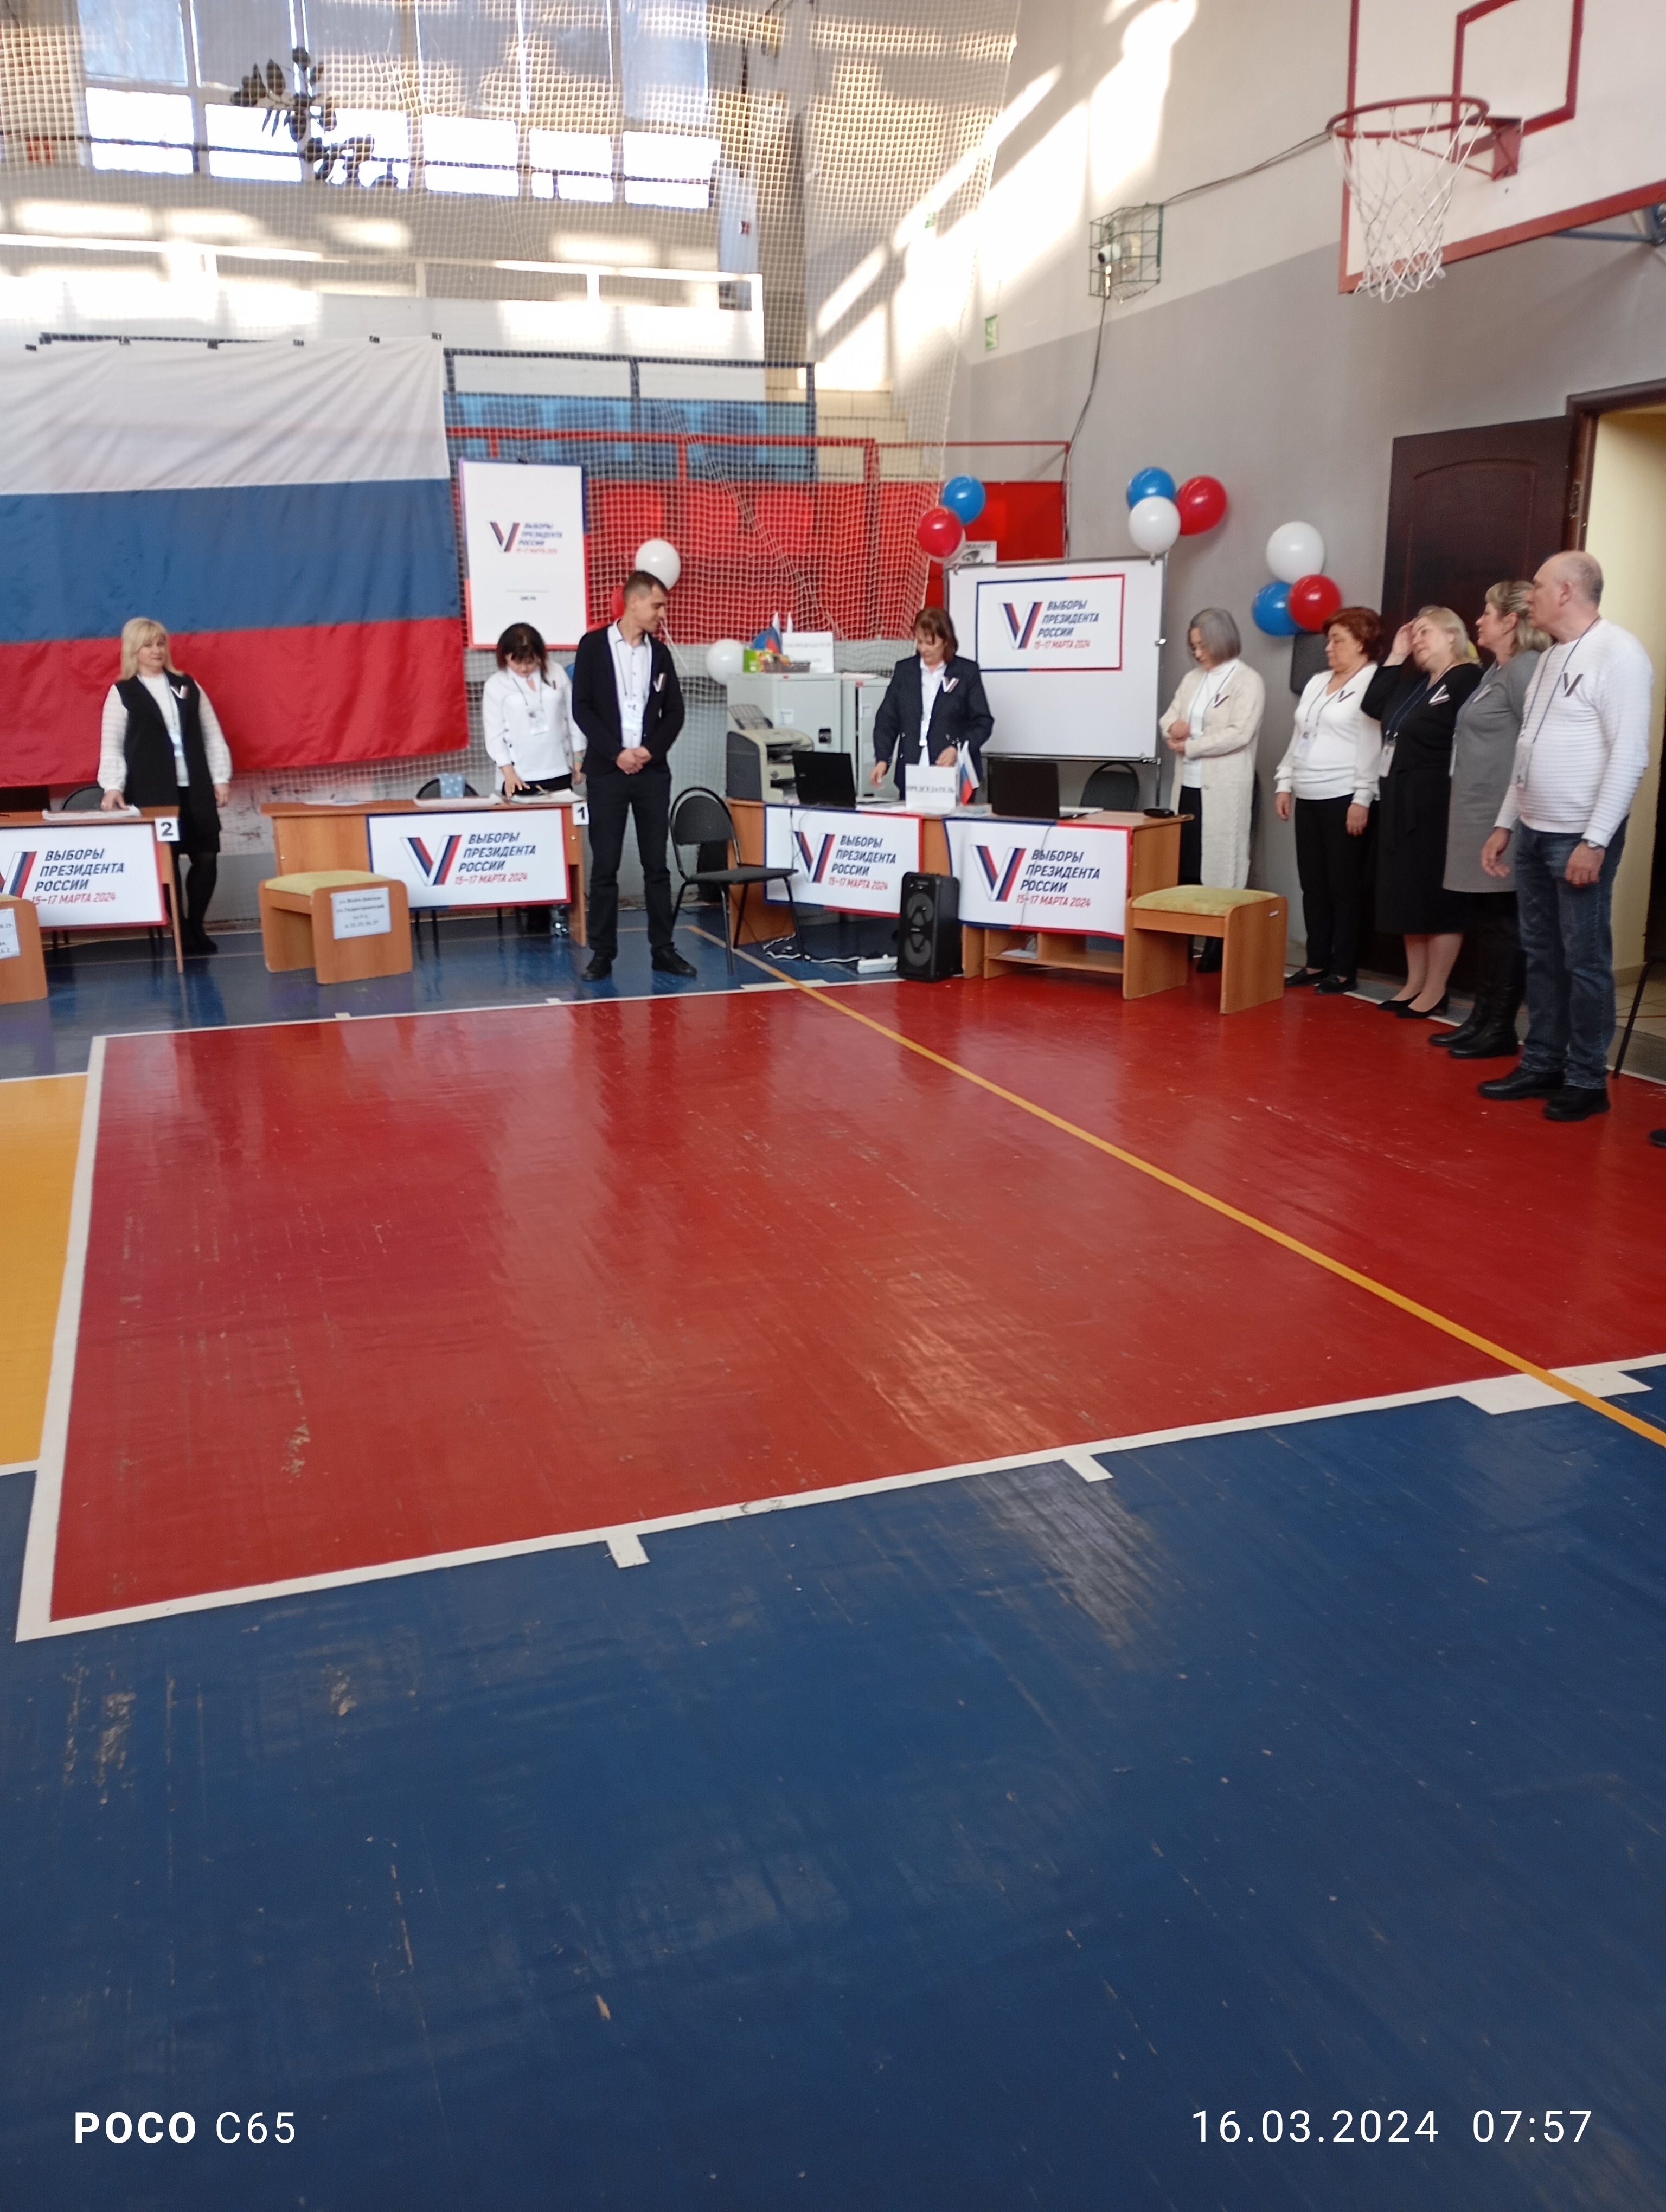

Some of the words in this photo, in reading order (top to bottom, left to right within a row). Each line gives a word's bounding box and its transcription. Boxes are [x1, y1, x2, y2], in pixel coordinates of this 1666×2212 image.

[1047, 600, 1088, 611] ВЫБОРЫ
[1042, 613, 1099, 624] ПРЕЗИДЕНТА
[1037, 627, 1074, 638] РОССИИ
[578, 807, 586, 820] 1
[161, 822, 174, 836] 2
[469, 832, 521, 845] ВЫБОРЫ
[840, 835, 883, 848] ВЫБОРЫ
[45, 848, 104, 861] ВЫБОРЫ
[463, 845, 536, 858] ПРЕЗИДЕНТА
[836, 849, 896, 864] ПРЕЗИДЕНТА
[1031, 850, 1084, 863] ВЫБОРЫ
[40, 863, 124, 877] ПРЕЗИДЕНТА
[458, 860, 507, 872] РОССИИ
[831, 863, 870, 876] РОССИИ
[1026, 864, 1100, 879] ПРЕЗИДЕНТА
[35, 879, 89, 892] РОССИИ
[479, 874, 507, 884] МАРТА
[847, 879, 870, 889] МАРТА
[1020, 880, 1068, 893] РОССИИ
[59, 893, 91, 904] МАРТА
[1041, 896, 1068, 906] МАРТА
[1069, 897, 1091, 908] 2024
